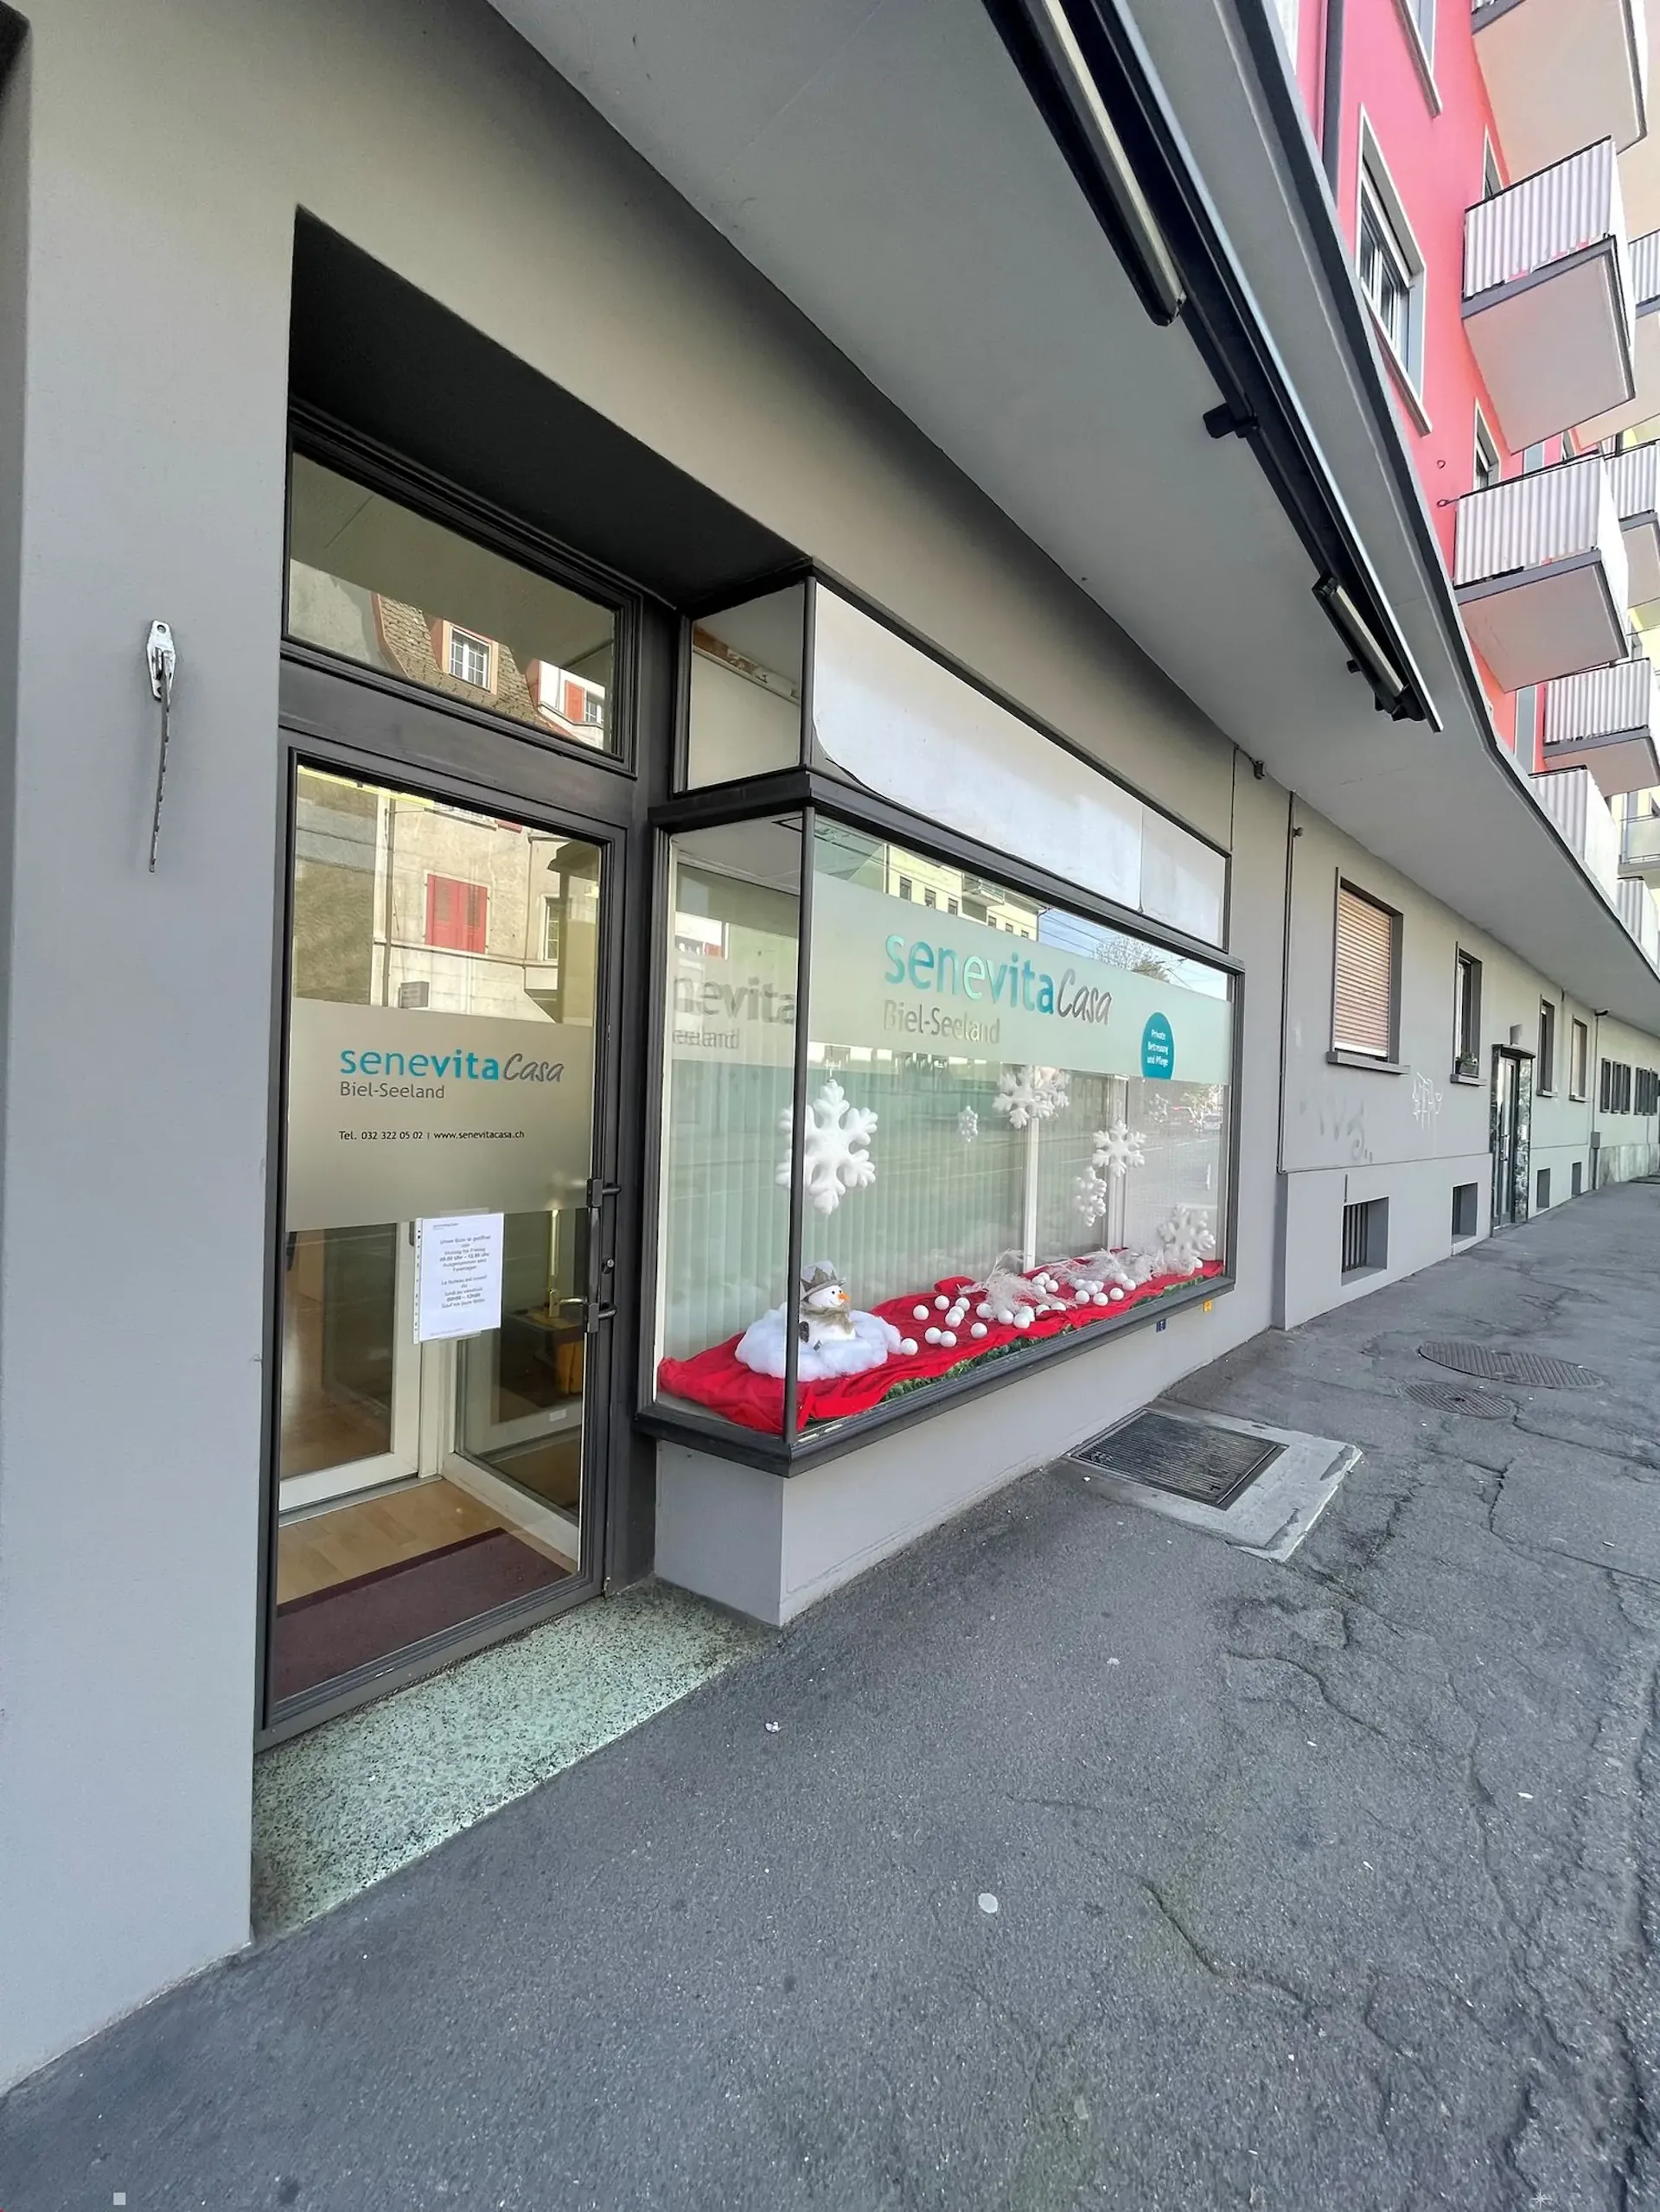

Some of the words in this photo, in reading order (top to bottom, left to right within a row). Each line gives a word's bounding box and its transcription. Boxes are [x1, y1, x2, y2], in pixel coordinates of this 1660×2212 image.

[884, 999, 1000, 1044] Biel-Seeland
[340, 1081, 445, 1099] Biel-Seeland
[339, 1131, 357, 1140] Tel.
[361, 1131, 378, 1140] 032
[381, 1131, 397, 1140] 322
[399, 1131, 411, 1140] 05
[412, 1131, 423, 1140] 02
[433, 1130, 525, 1140] www.senevitacasa.ch
